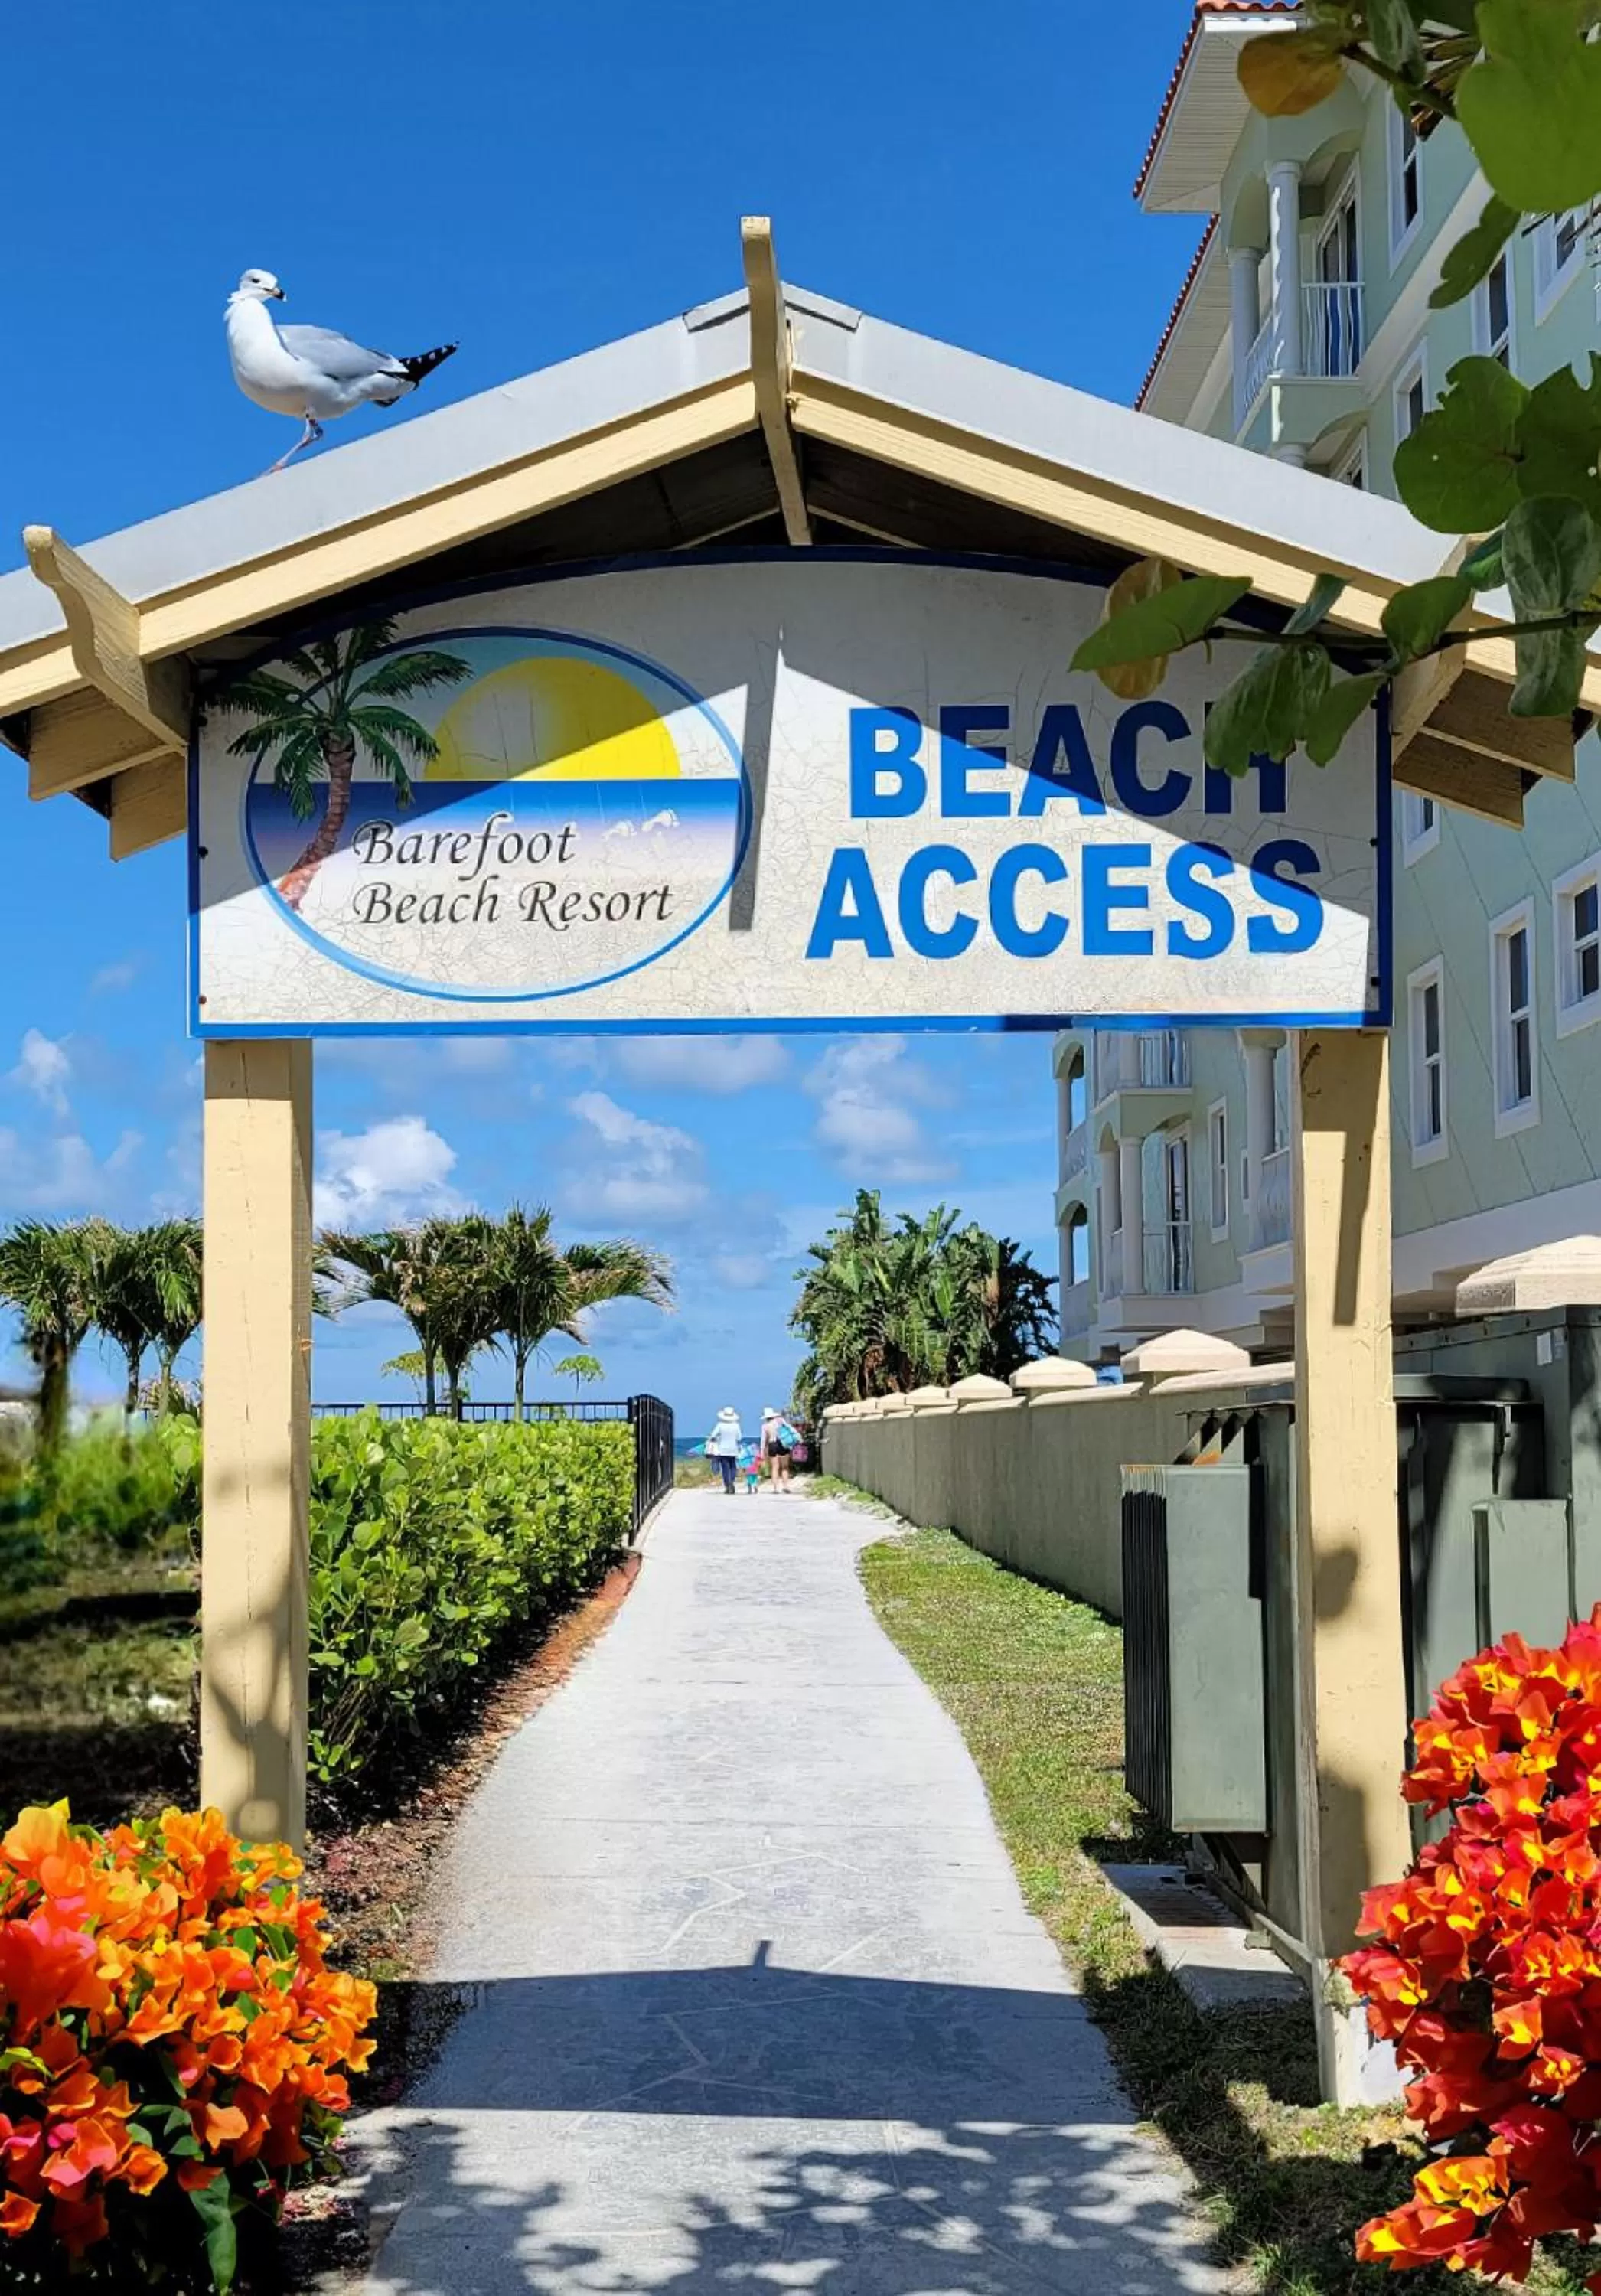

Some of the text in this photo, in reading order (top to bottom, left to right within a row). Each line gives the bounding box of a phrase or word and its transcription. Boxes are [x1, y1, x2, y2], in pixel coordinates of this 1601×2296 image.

[353, 814, 576, 880] Barefoot
[353, 875, 673, 931] Beach Resort
[804, 839, 1324, 960] ACCESS
